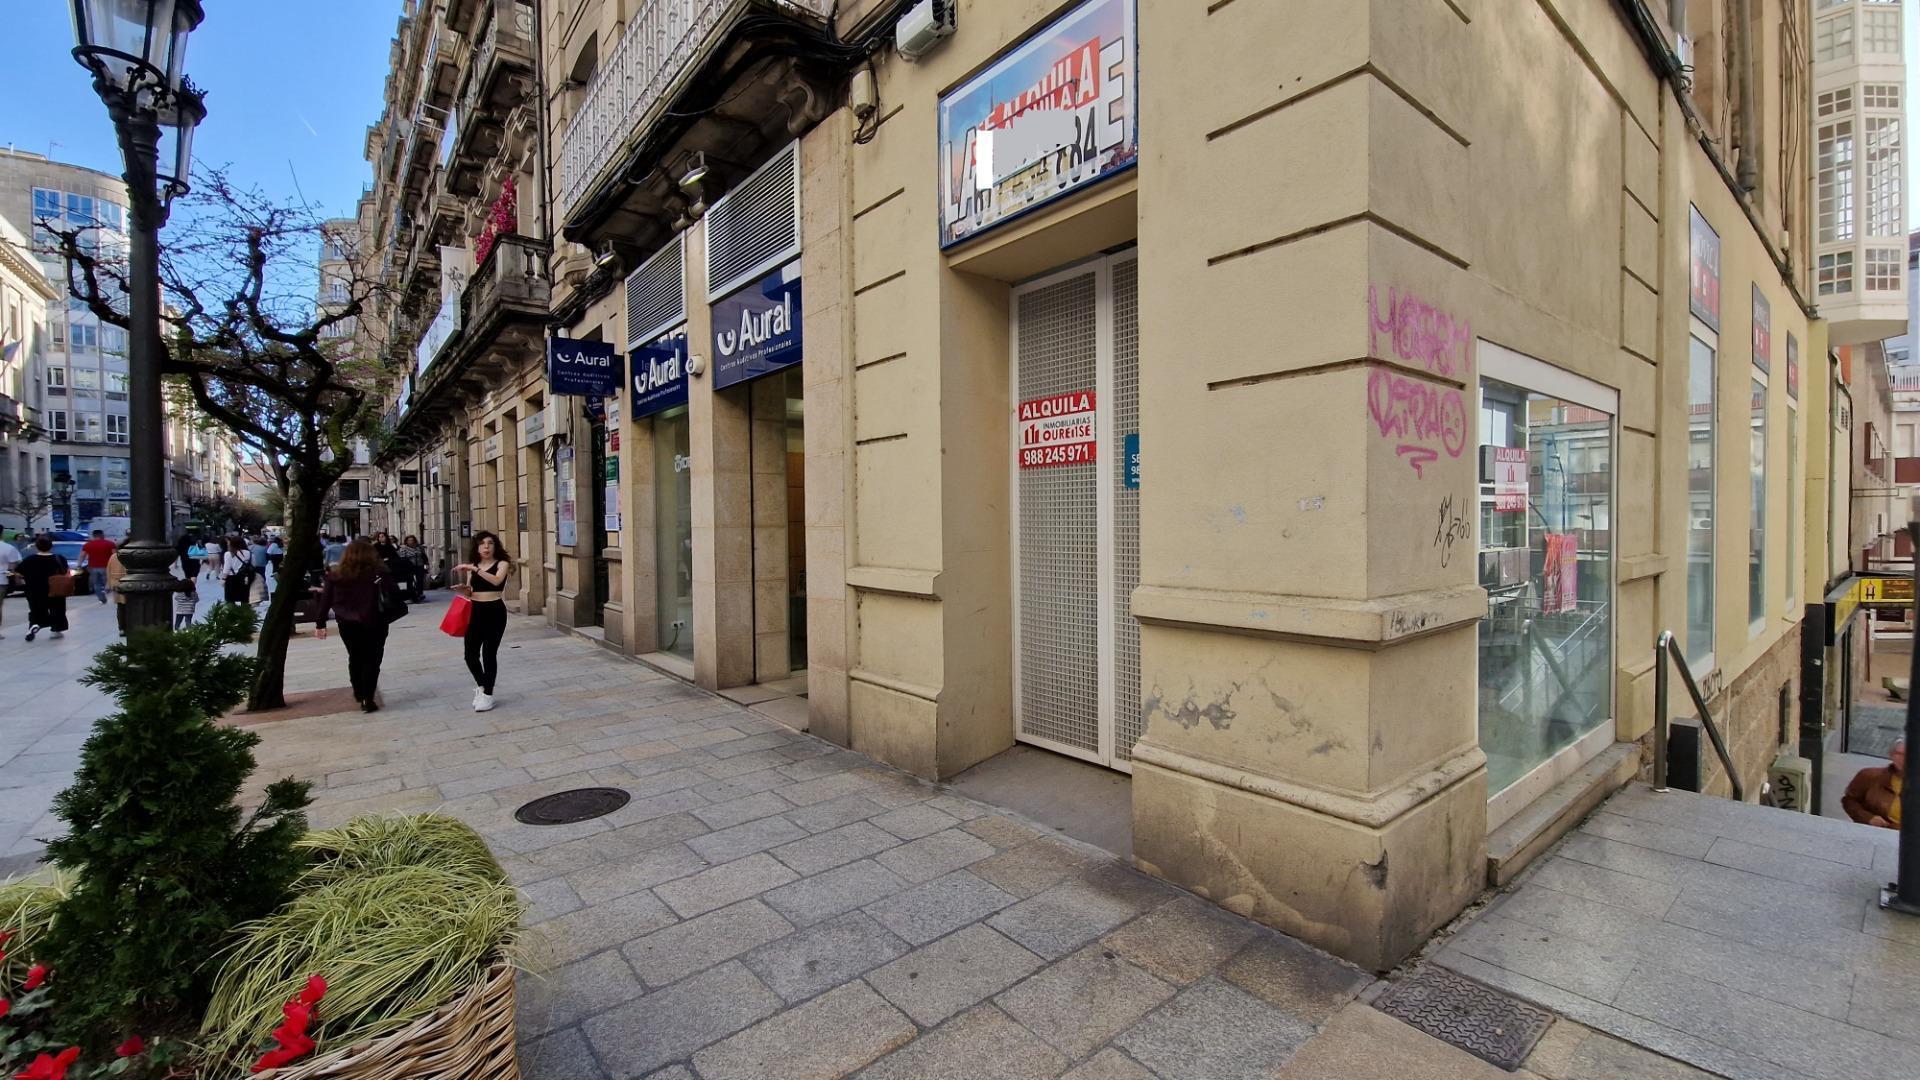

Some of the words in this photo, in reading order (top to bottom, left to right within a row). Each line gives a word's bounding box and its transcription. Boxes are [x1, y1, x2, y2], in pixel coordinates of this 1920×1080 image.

[738, 291, 791, 351] Aural
[574, 351, 610, 367] Aural
[648, 347, 681, 390] Aural
[1022, 394, 1090, 419] ALQUILA
[1043, 416, 1091, 429] INMOBILIARIAS
[1024, 449, 1044, 465] 988
[1045, 446, 1066, 463] 245
[1067, 444, 1089, 461] 971
[1496, 448, 1526, 462] ALQUILA
